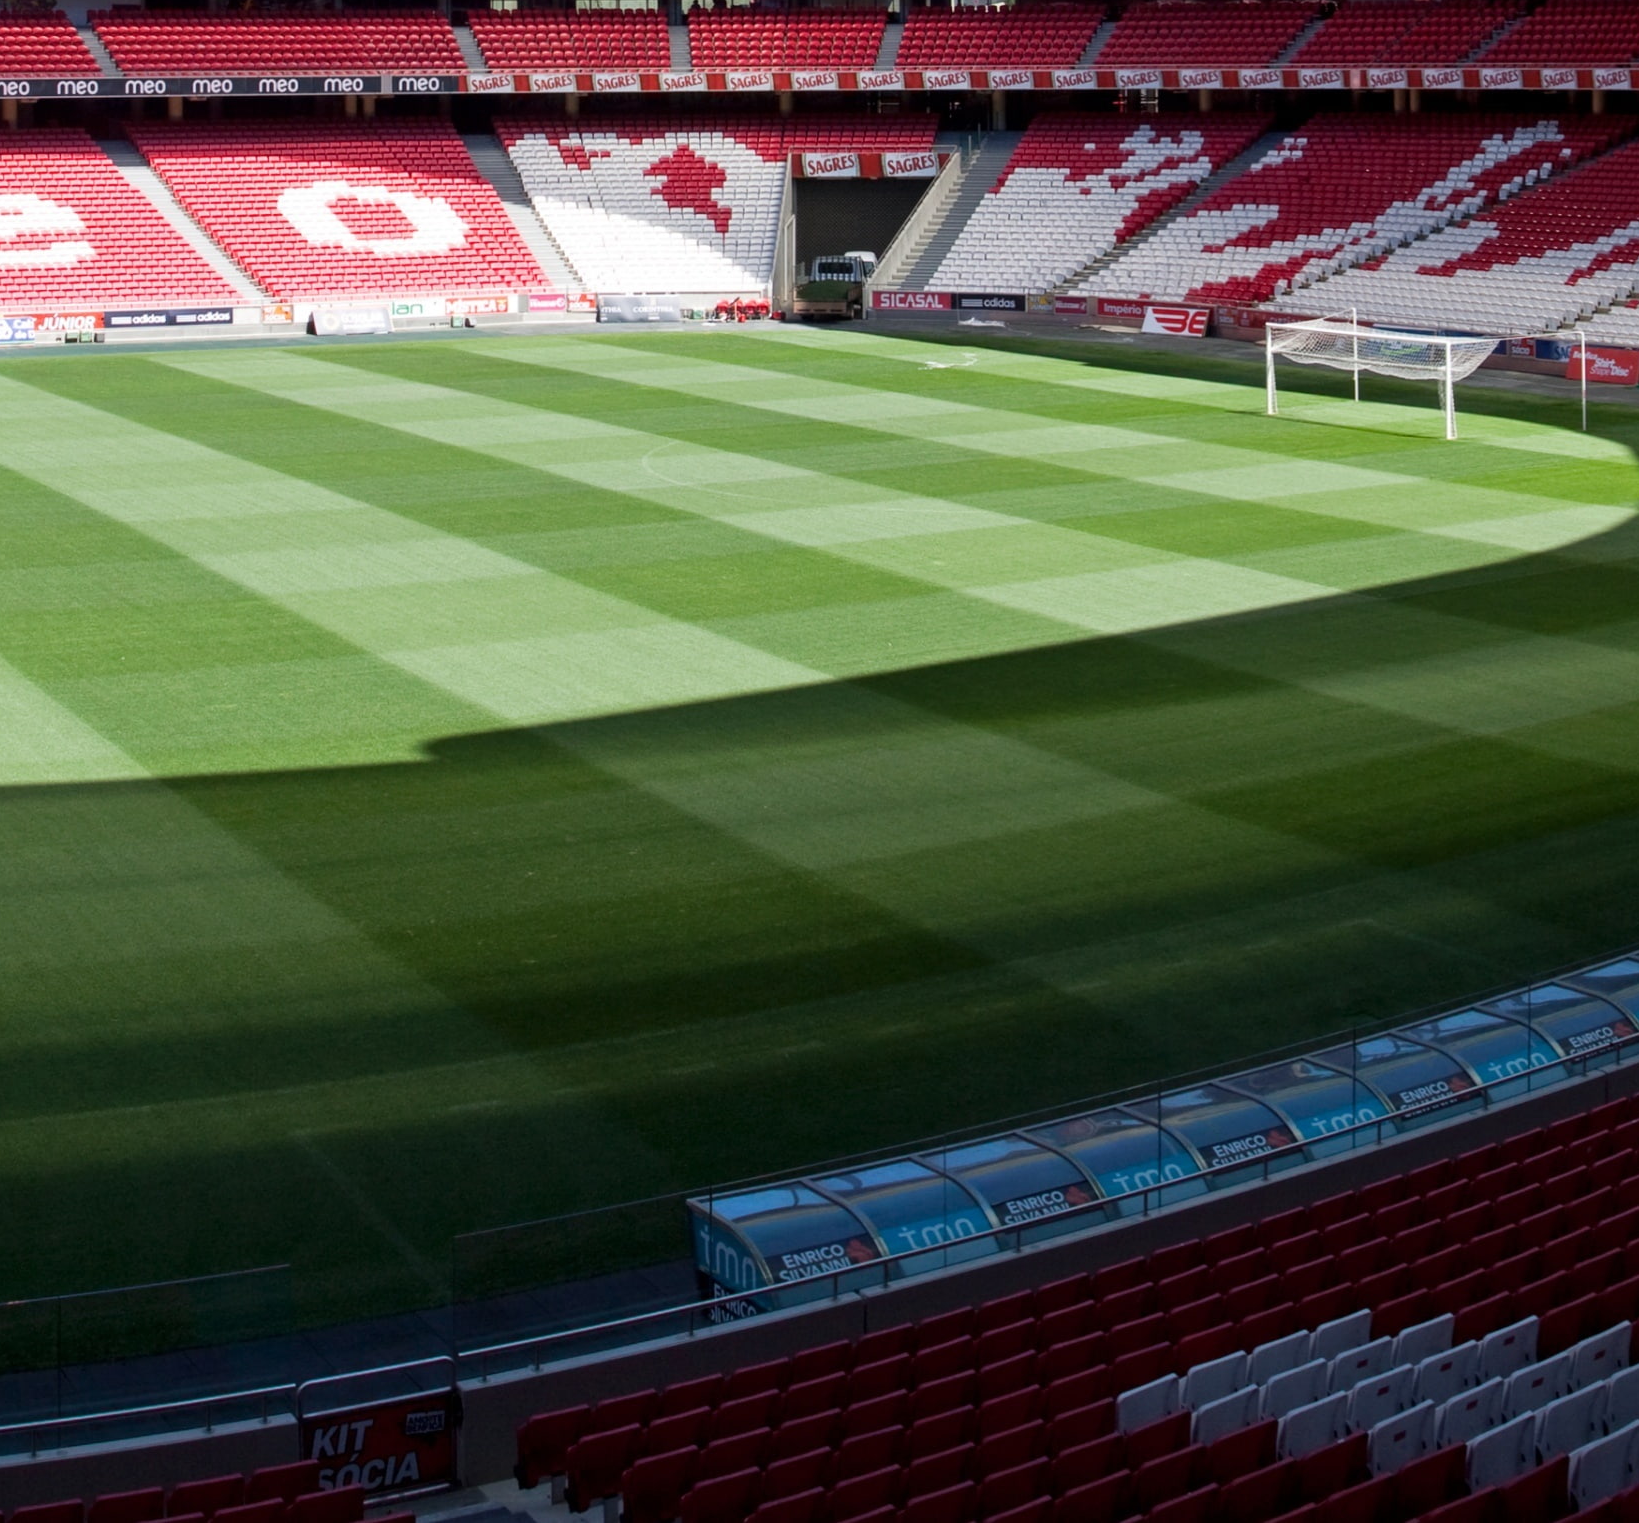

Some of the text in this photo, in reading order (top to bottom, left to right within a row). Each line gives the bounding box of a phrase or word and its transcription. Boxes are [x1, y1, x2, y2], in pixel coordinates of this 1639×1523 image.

[399, 78, 439, 91] meo
[1181, 70, 1220, 88] SAGRES
[808, 154, 855, 175] SAGRES
[887, 154, 935, 175] SAGRES
[879, 293, 943, 309] SICASAL
[983, 298, 1016, 309] adidas
[132, 315, 166, 324] adidas
[197, 312, 230, 322] adidas
[1103, 304, 1142, 317] Império
[38, 313, 96, 330] JÚNIOR
[1573, 350, 1616, 368] Benfica Shirt
[1610, 366, 1630, 377] Disc
[1569, 1026, 1615, 1049] ENRICO
[1211, 1134, 1267, 1159] ENRICO
[1113, 1163, 1184, 1194] tmn
[700, 1224, 757, 1290] tmn
[781, 1243, 845, 1269] ENRICO
[310, 1418, 374, 1460] KIT
[317, 1450, 421, 1493] SÓCIA
